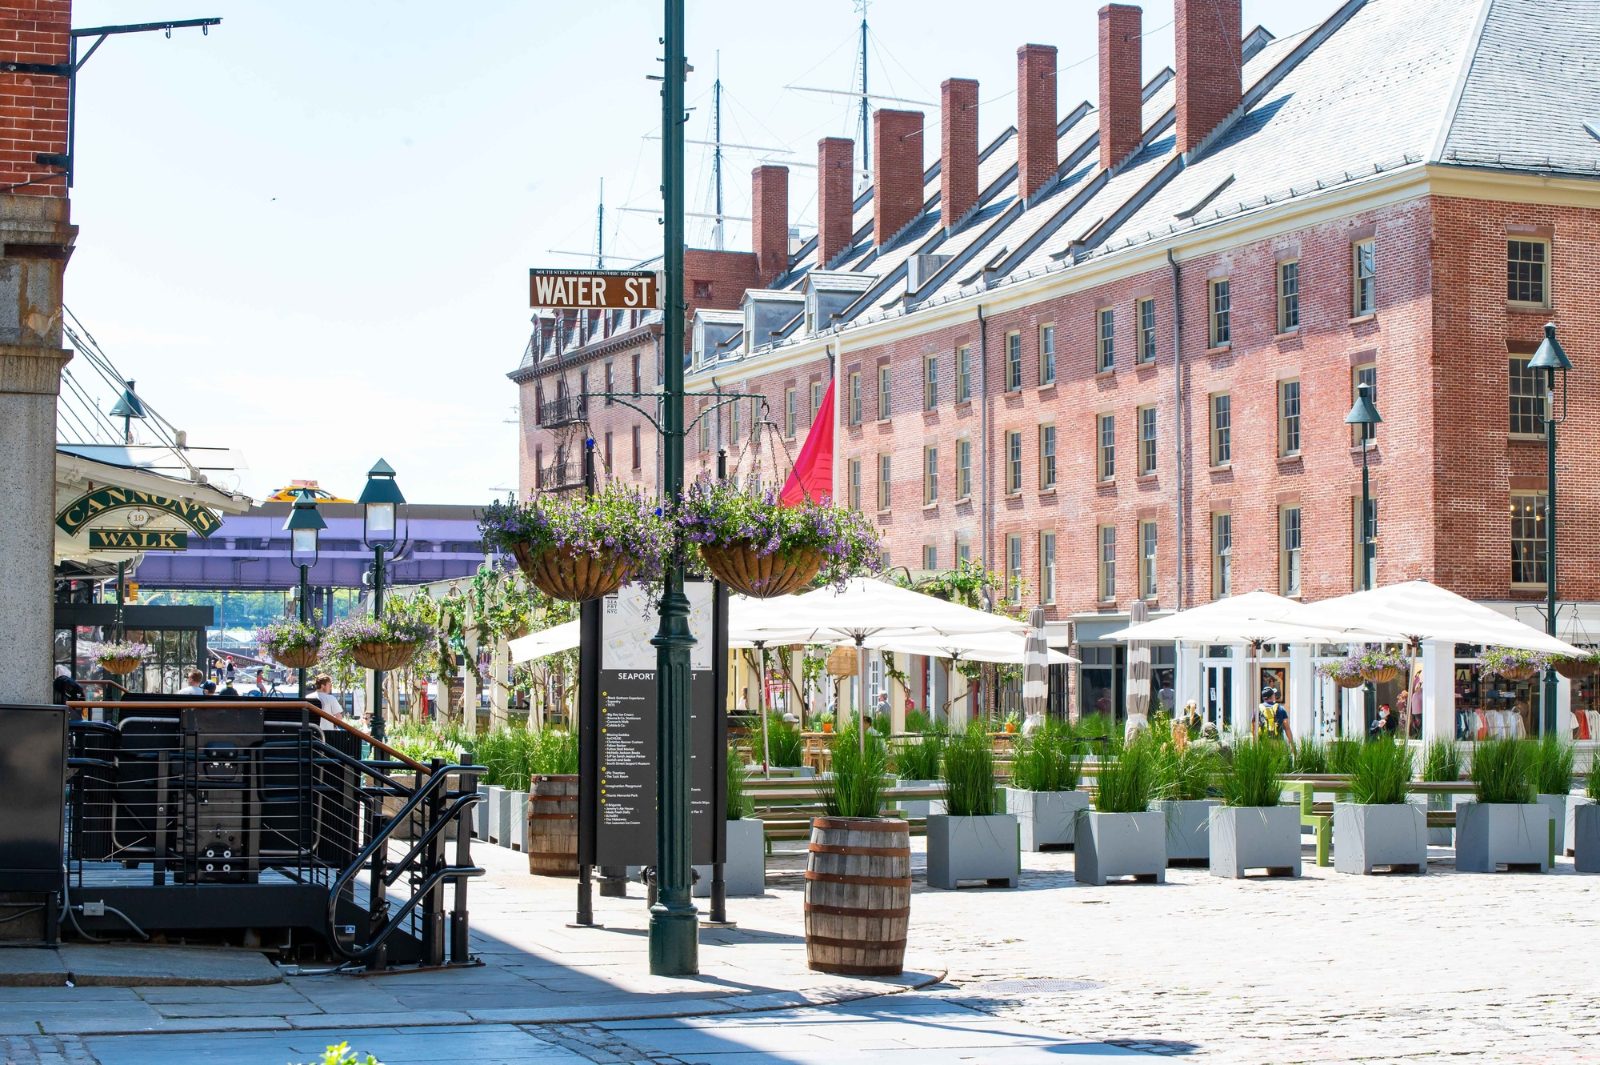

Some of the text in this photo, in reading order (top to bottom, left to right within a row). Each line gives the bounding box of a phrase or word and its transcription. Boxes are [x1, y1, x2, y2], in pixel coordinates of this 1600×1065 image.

[535, 276, 651, 306] WATER ST
[64, 486, 214, 531] CANNON'S
[133, 514, 145, 522] 19
[97, 532, 178, 548] WALK
[618, 672, 655, 680] SEAPORT
